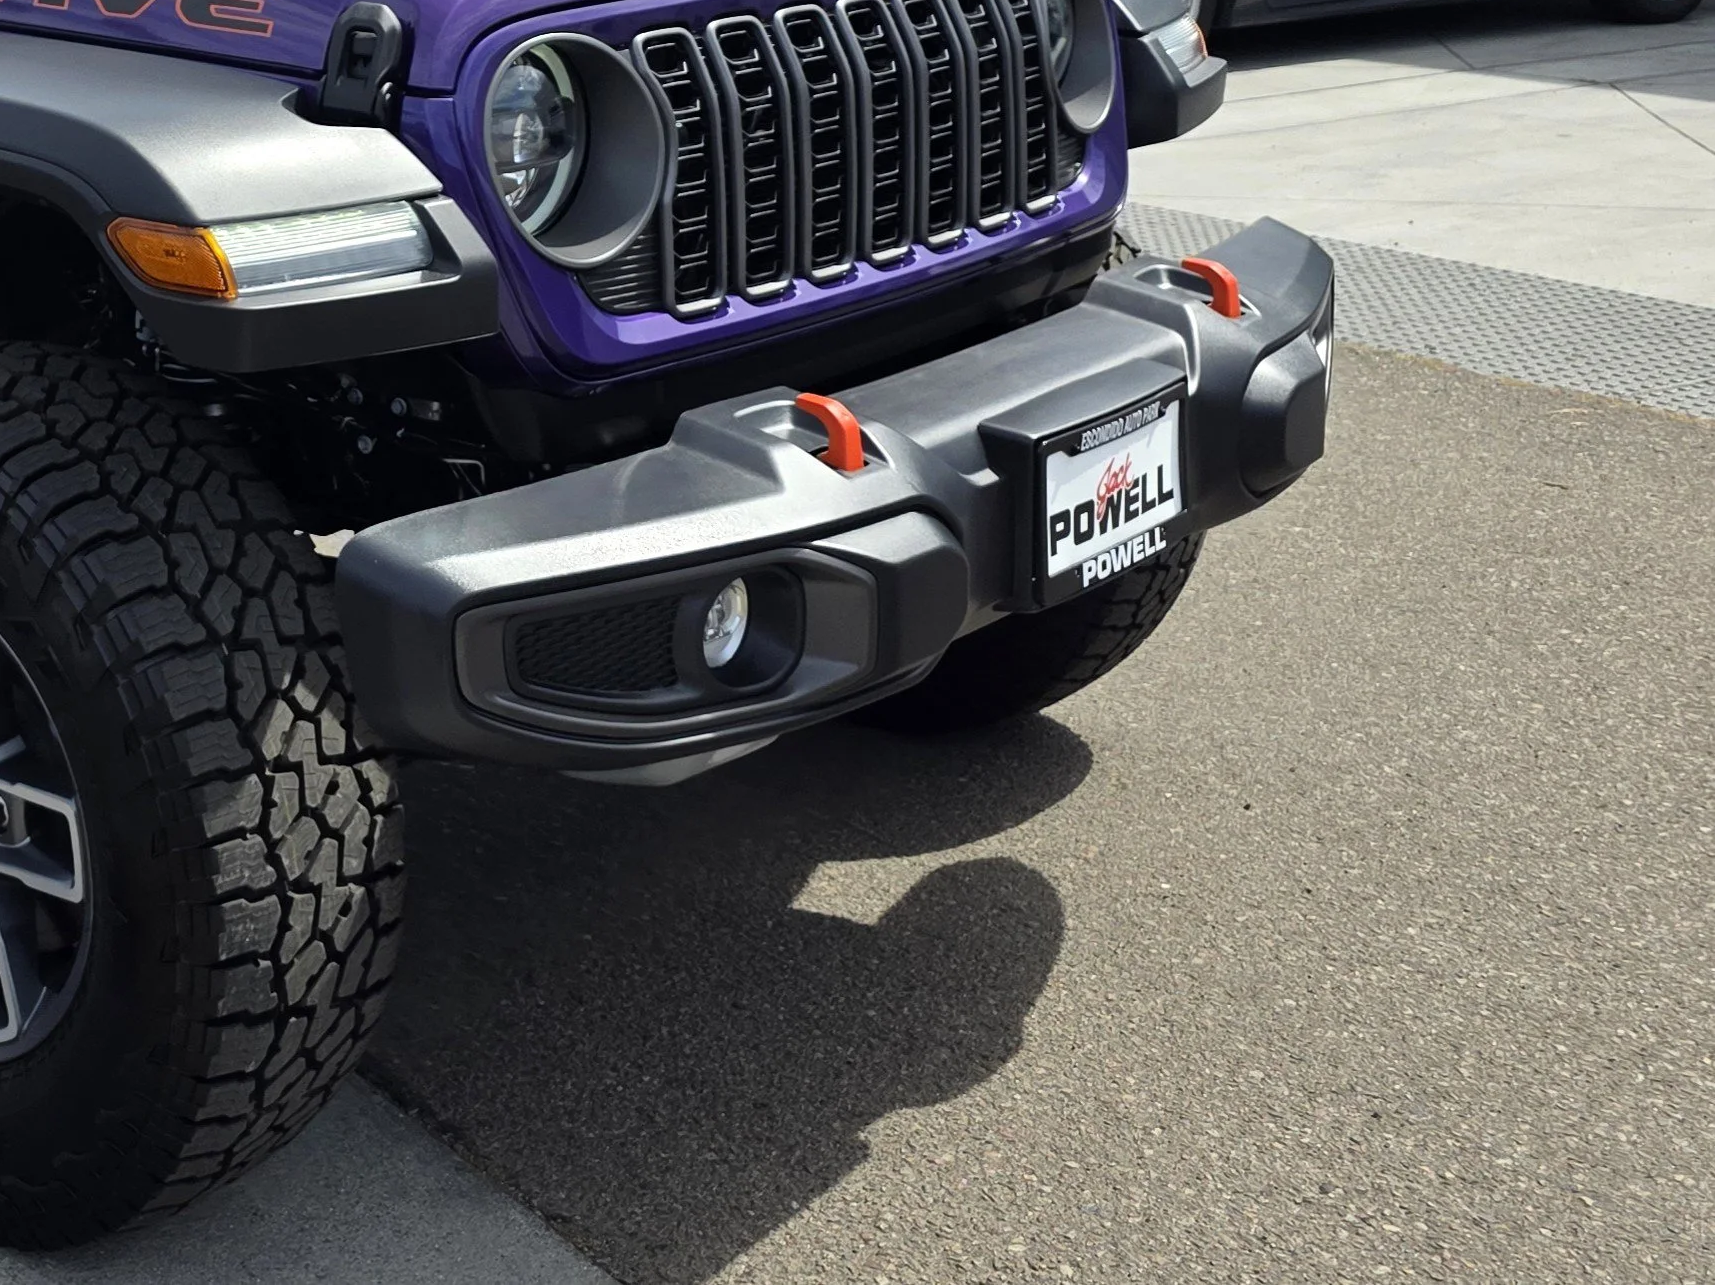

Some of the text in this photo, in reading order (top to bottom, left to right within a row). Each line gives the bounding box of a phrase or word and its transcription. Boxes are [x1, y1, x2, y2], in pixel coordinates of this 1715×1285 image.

[1080, 400, 1161, 452] ESCONDIDO AUTO PARK
[1049, 464, 1175, 557] POWELL
[1096, 452, 1135, 522] Jack
[1081, 526, 1167, 588] POWELL
